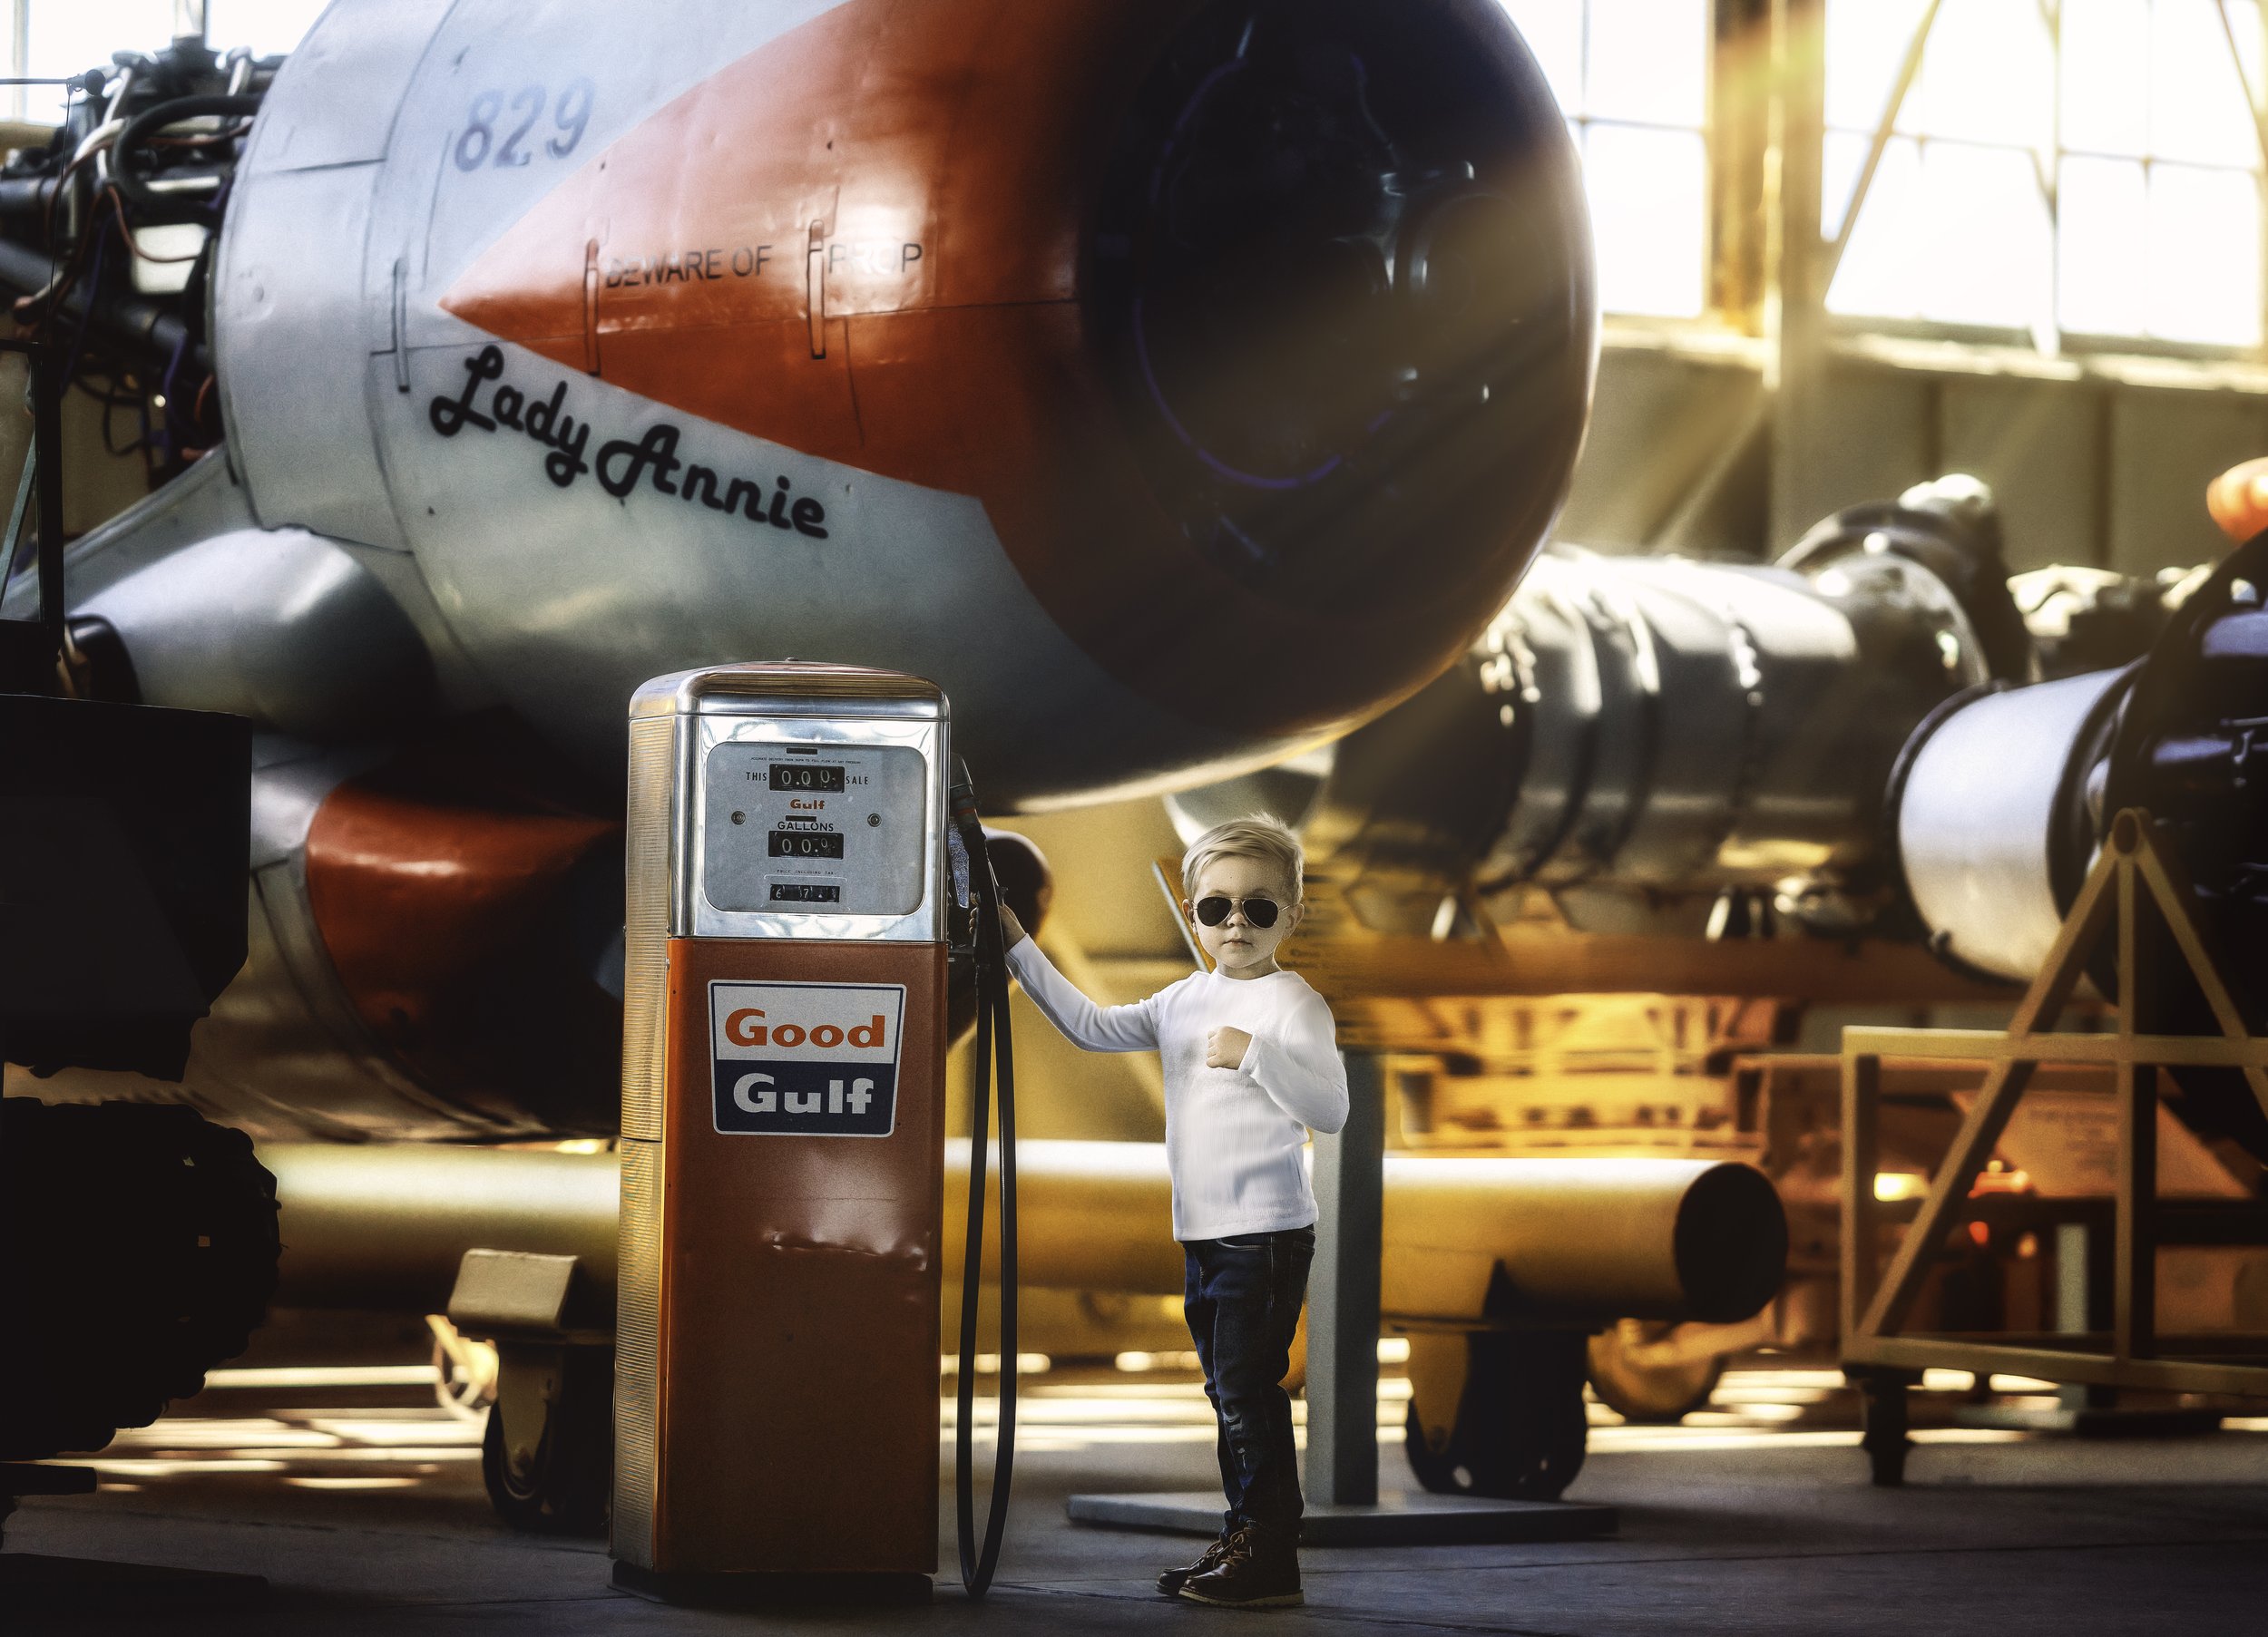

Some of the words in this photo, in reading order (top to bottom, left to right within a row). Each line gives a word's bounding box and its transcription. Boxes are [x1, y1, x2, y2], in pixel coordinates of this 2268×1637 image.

[455, 76, 595, 172] 829
[606, 248, 723, 288] BEWARE
[731, 244, 773, 278] OF
[429, 345, 591, 488] Lady
[595, 424, 829, 540] Annie
[746, 772, 767, 781] THIS
[846, 775, 869, 785] SALE
[790, 799, 825, 810] Gulf
[777, 821, 834, 832] GALLONS
[725, 1008, 885, 1048] Good
[733, 1072, 875, 1115] Gulf
